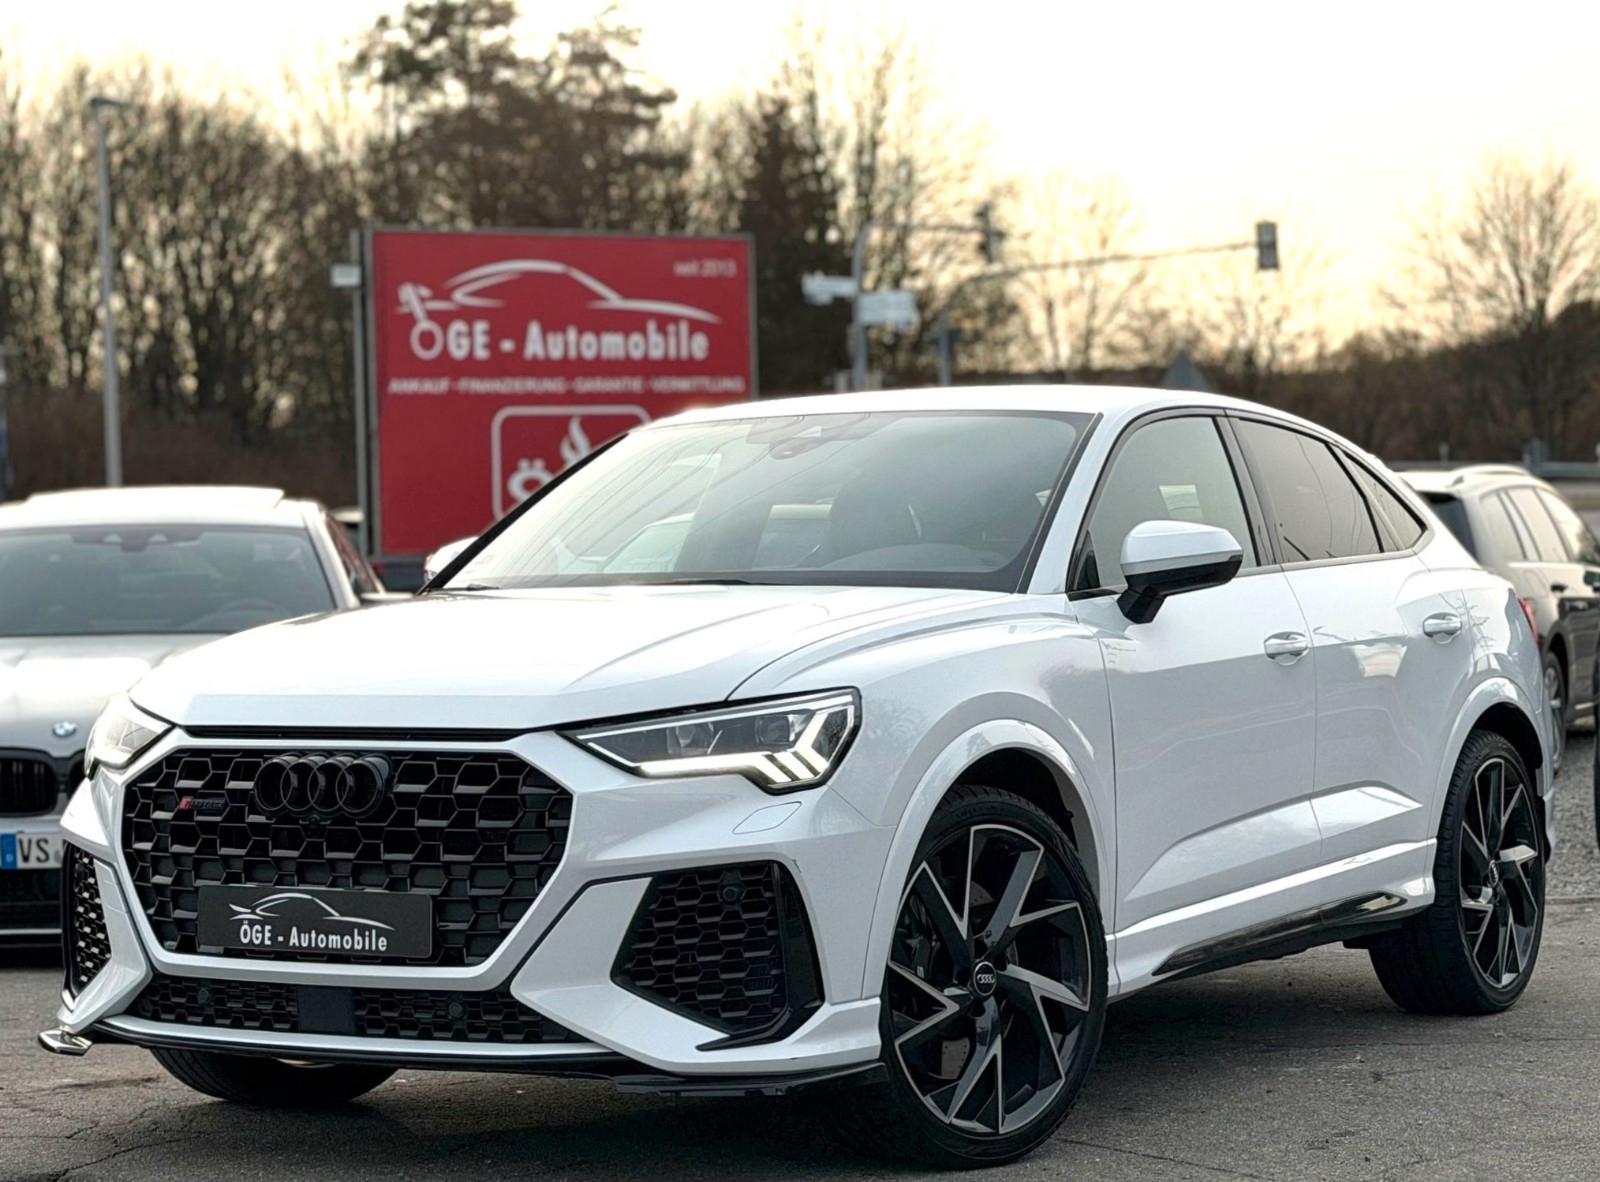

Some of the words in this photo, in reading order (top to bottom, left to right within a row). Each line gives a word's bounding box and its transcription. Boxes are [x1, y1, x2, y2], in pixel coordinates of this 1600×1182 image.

[524, 320, 709, 360] Automobile
[18, 837, 50, 863] VS
[240, 920, 272, 945] ÖGE
[289, 926, 388, 951] Automobile
